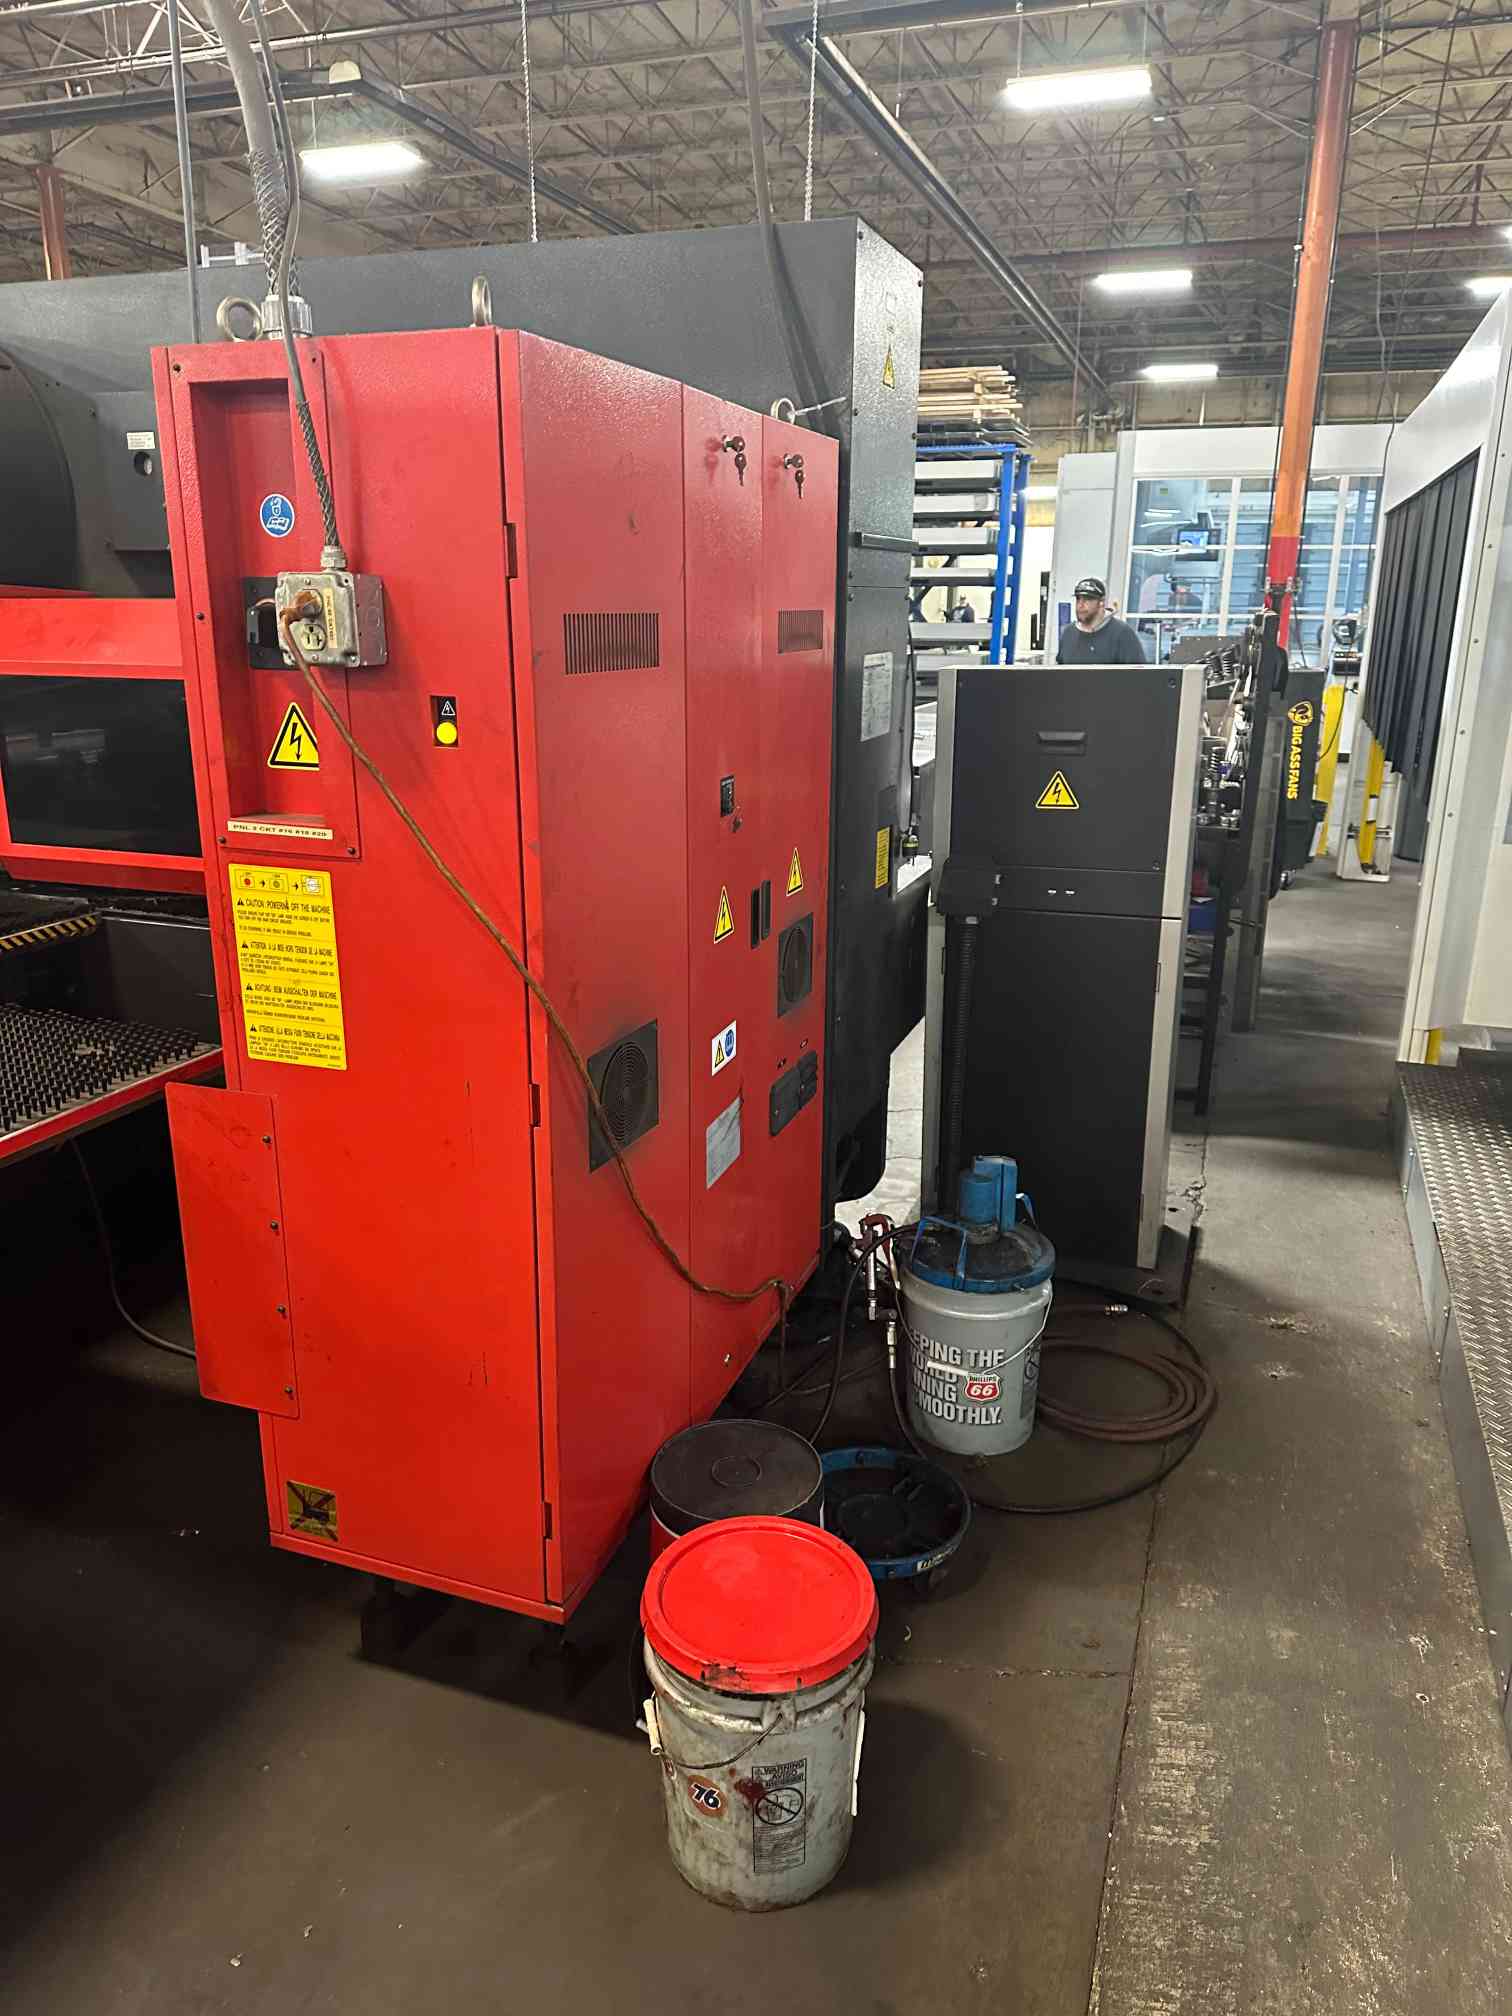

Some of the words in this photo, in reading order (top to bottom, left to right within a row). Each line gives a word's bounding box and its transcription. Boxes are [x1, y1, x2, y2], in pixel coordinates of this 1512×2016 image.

[1292, 725, 1303, 745] BIG
[1289, 745, 1303, 769] ASS
[1287, 769, 1300, 800] FANS
[967, 1348, 1005, 1368] THE
[969, 1384, 995, 1397] 66
[690, 1783, 721, 1810] 76
